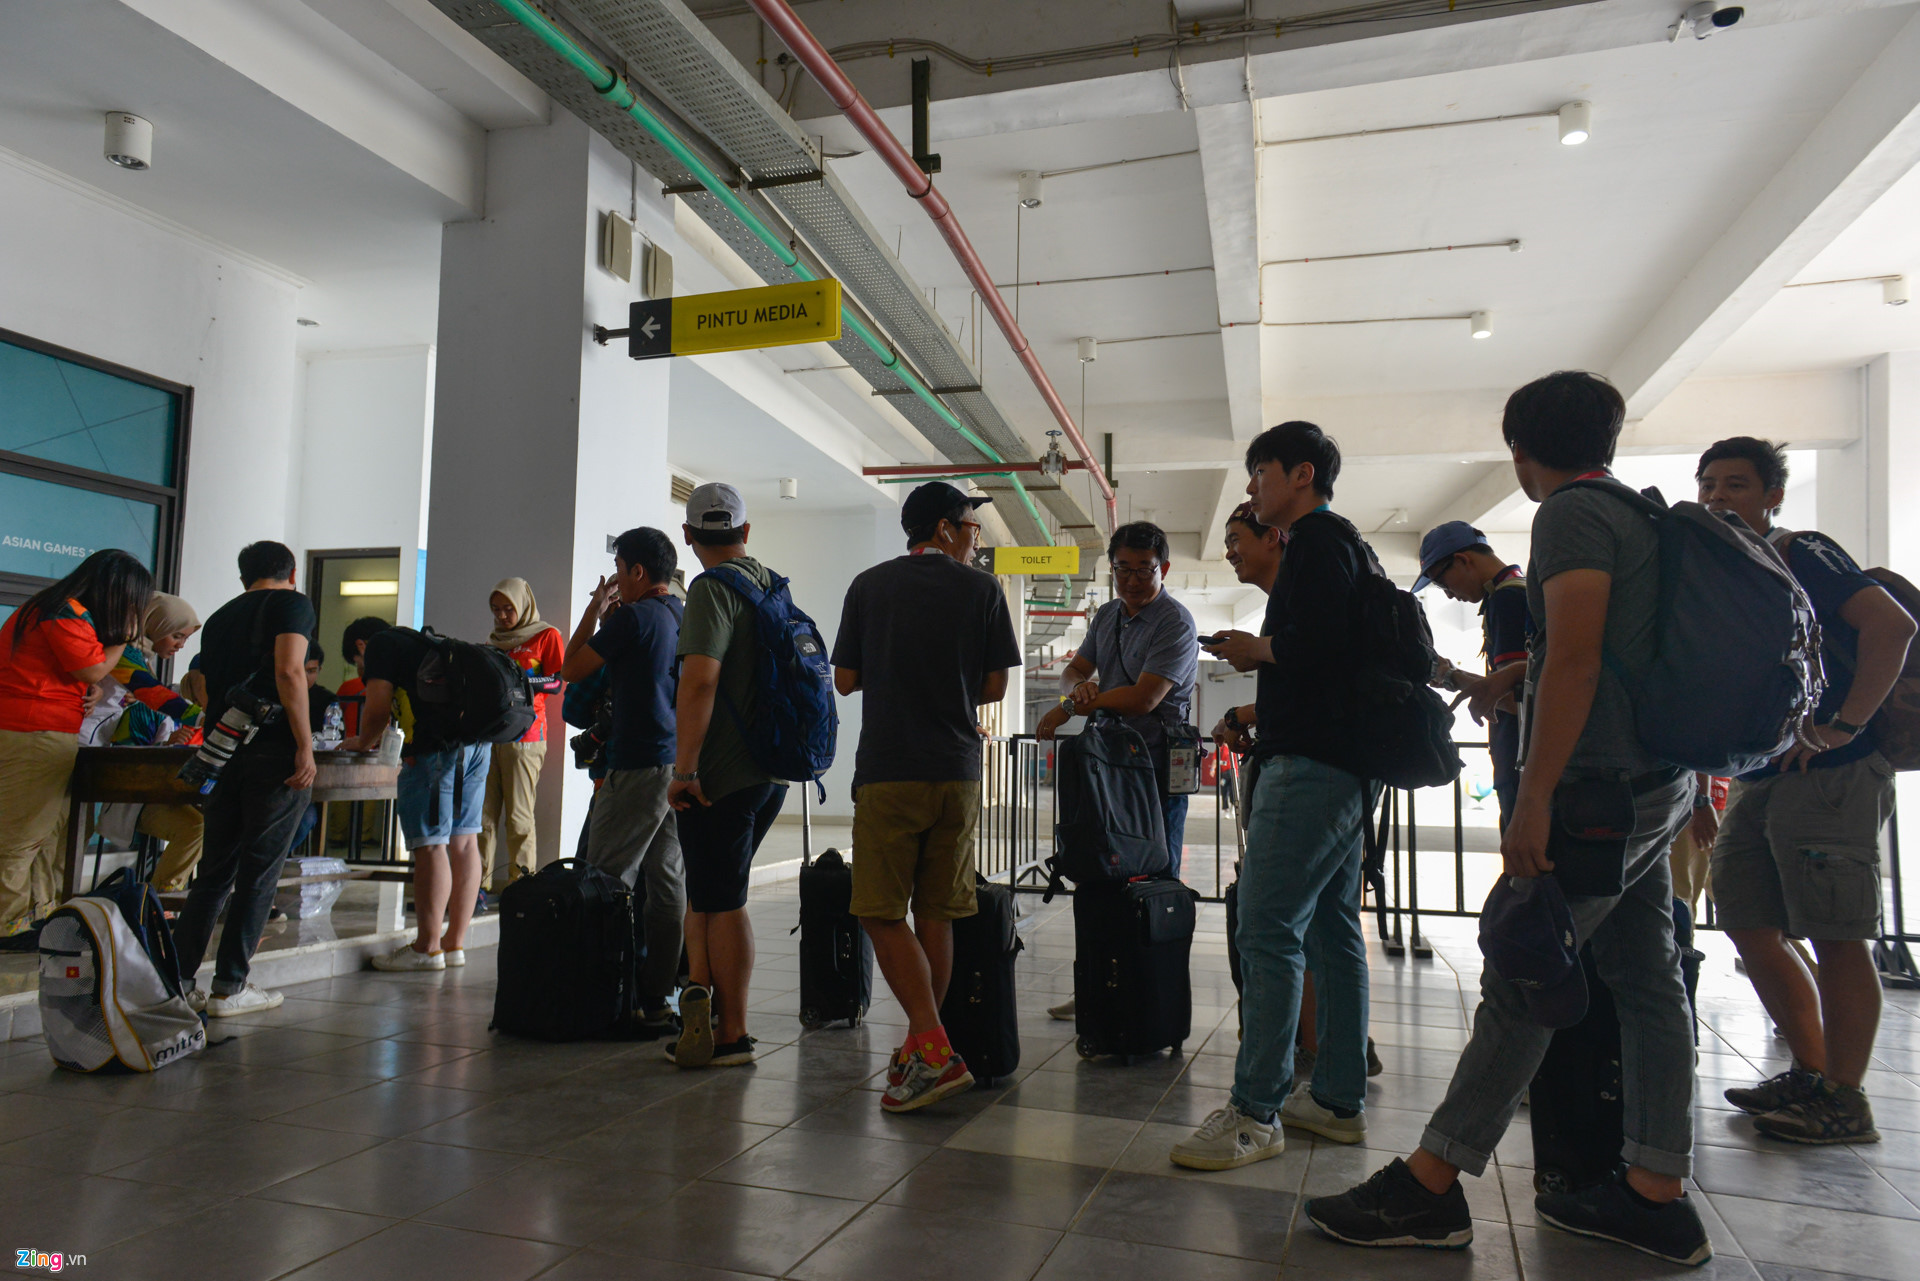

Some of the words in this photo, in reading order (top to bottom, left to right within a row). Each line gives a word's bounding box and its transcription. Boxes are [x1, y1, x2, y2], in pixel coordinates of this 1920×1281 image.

[697, 309, 748, 330] PINTU
[754, 302, 808, 324] MEDIA
[2, 535, 41, 551] ASIAN
[43, 541, 86, 558] GAMES
[1021, 555, 1052, 564] TOILET
[155, 1030, 204, 1063] mitre
